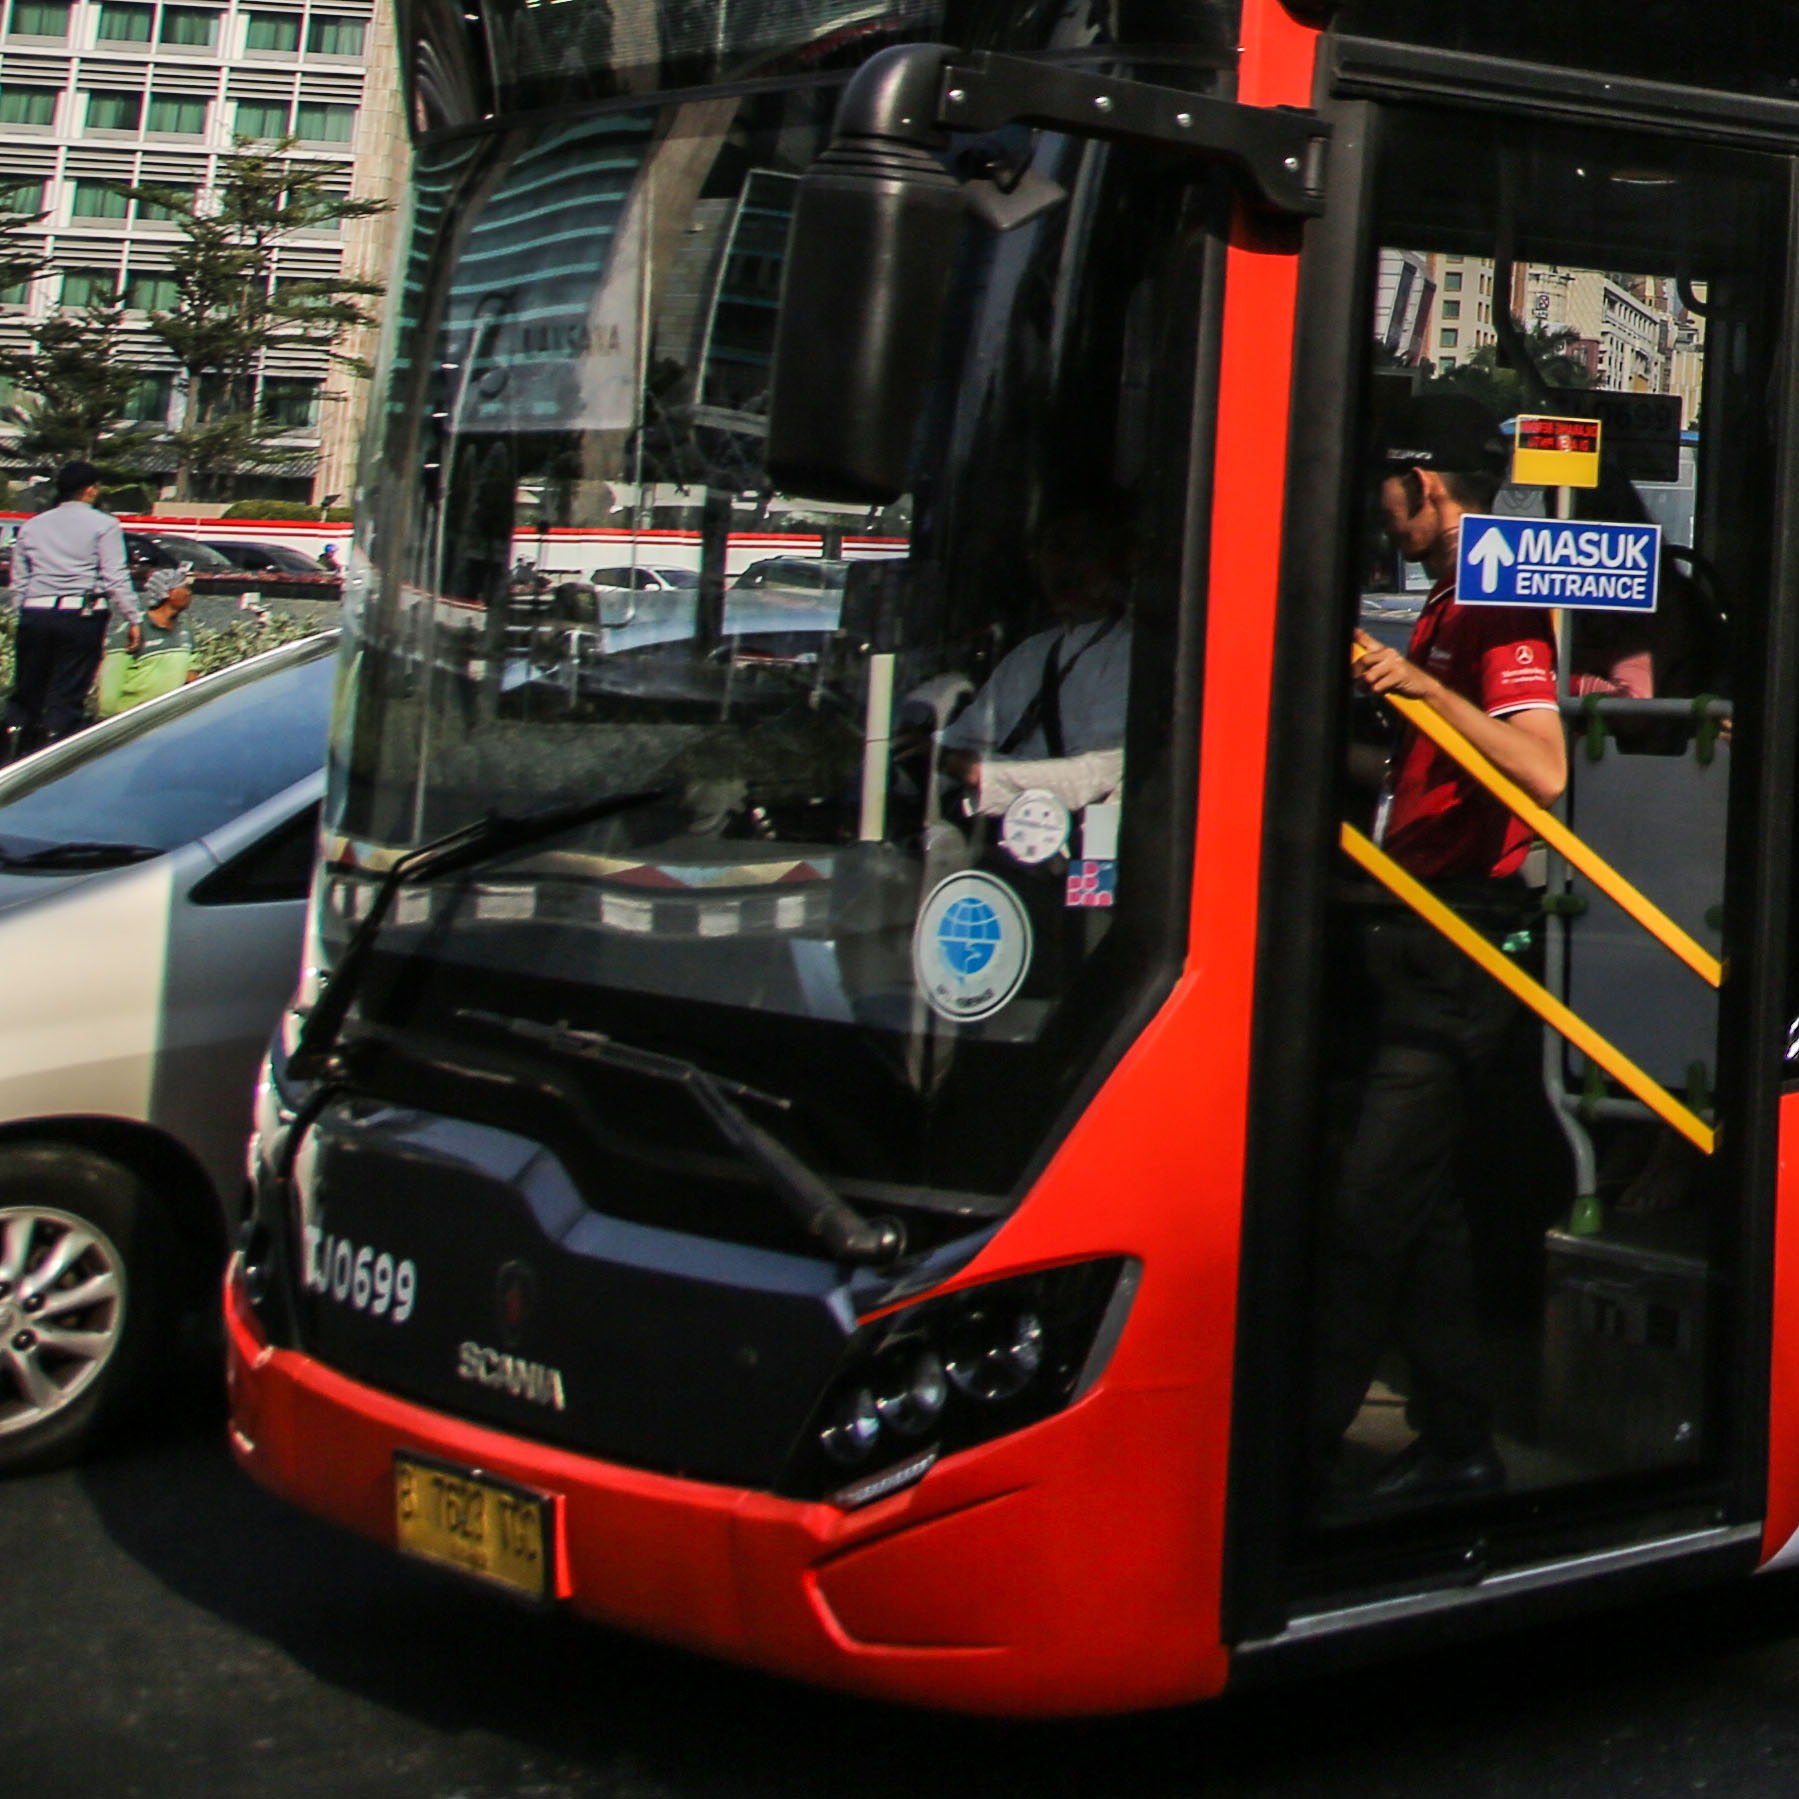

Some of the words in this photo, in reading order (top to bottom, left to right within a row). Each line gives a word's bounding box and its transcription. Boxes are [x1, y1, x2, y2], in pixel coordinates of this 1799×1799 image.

[1517, 528, 1650, 569] MASUK
[1515, 571, 1647, 600] ENTRANCE
[458, 1341, 566, 1412] SCANIA
